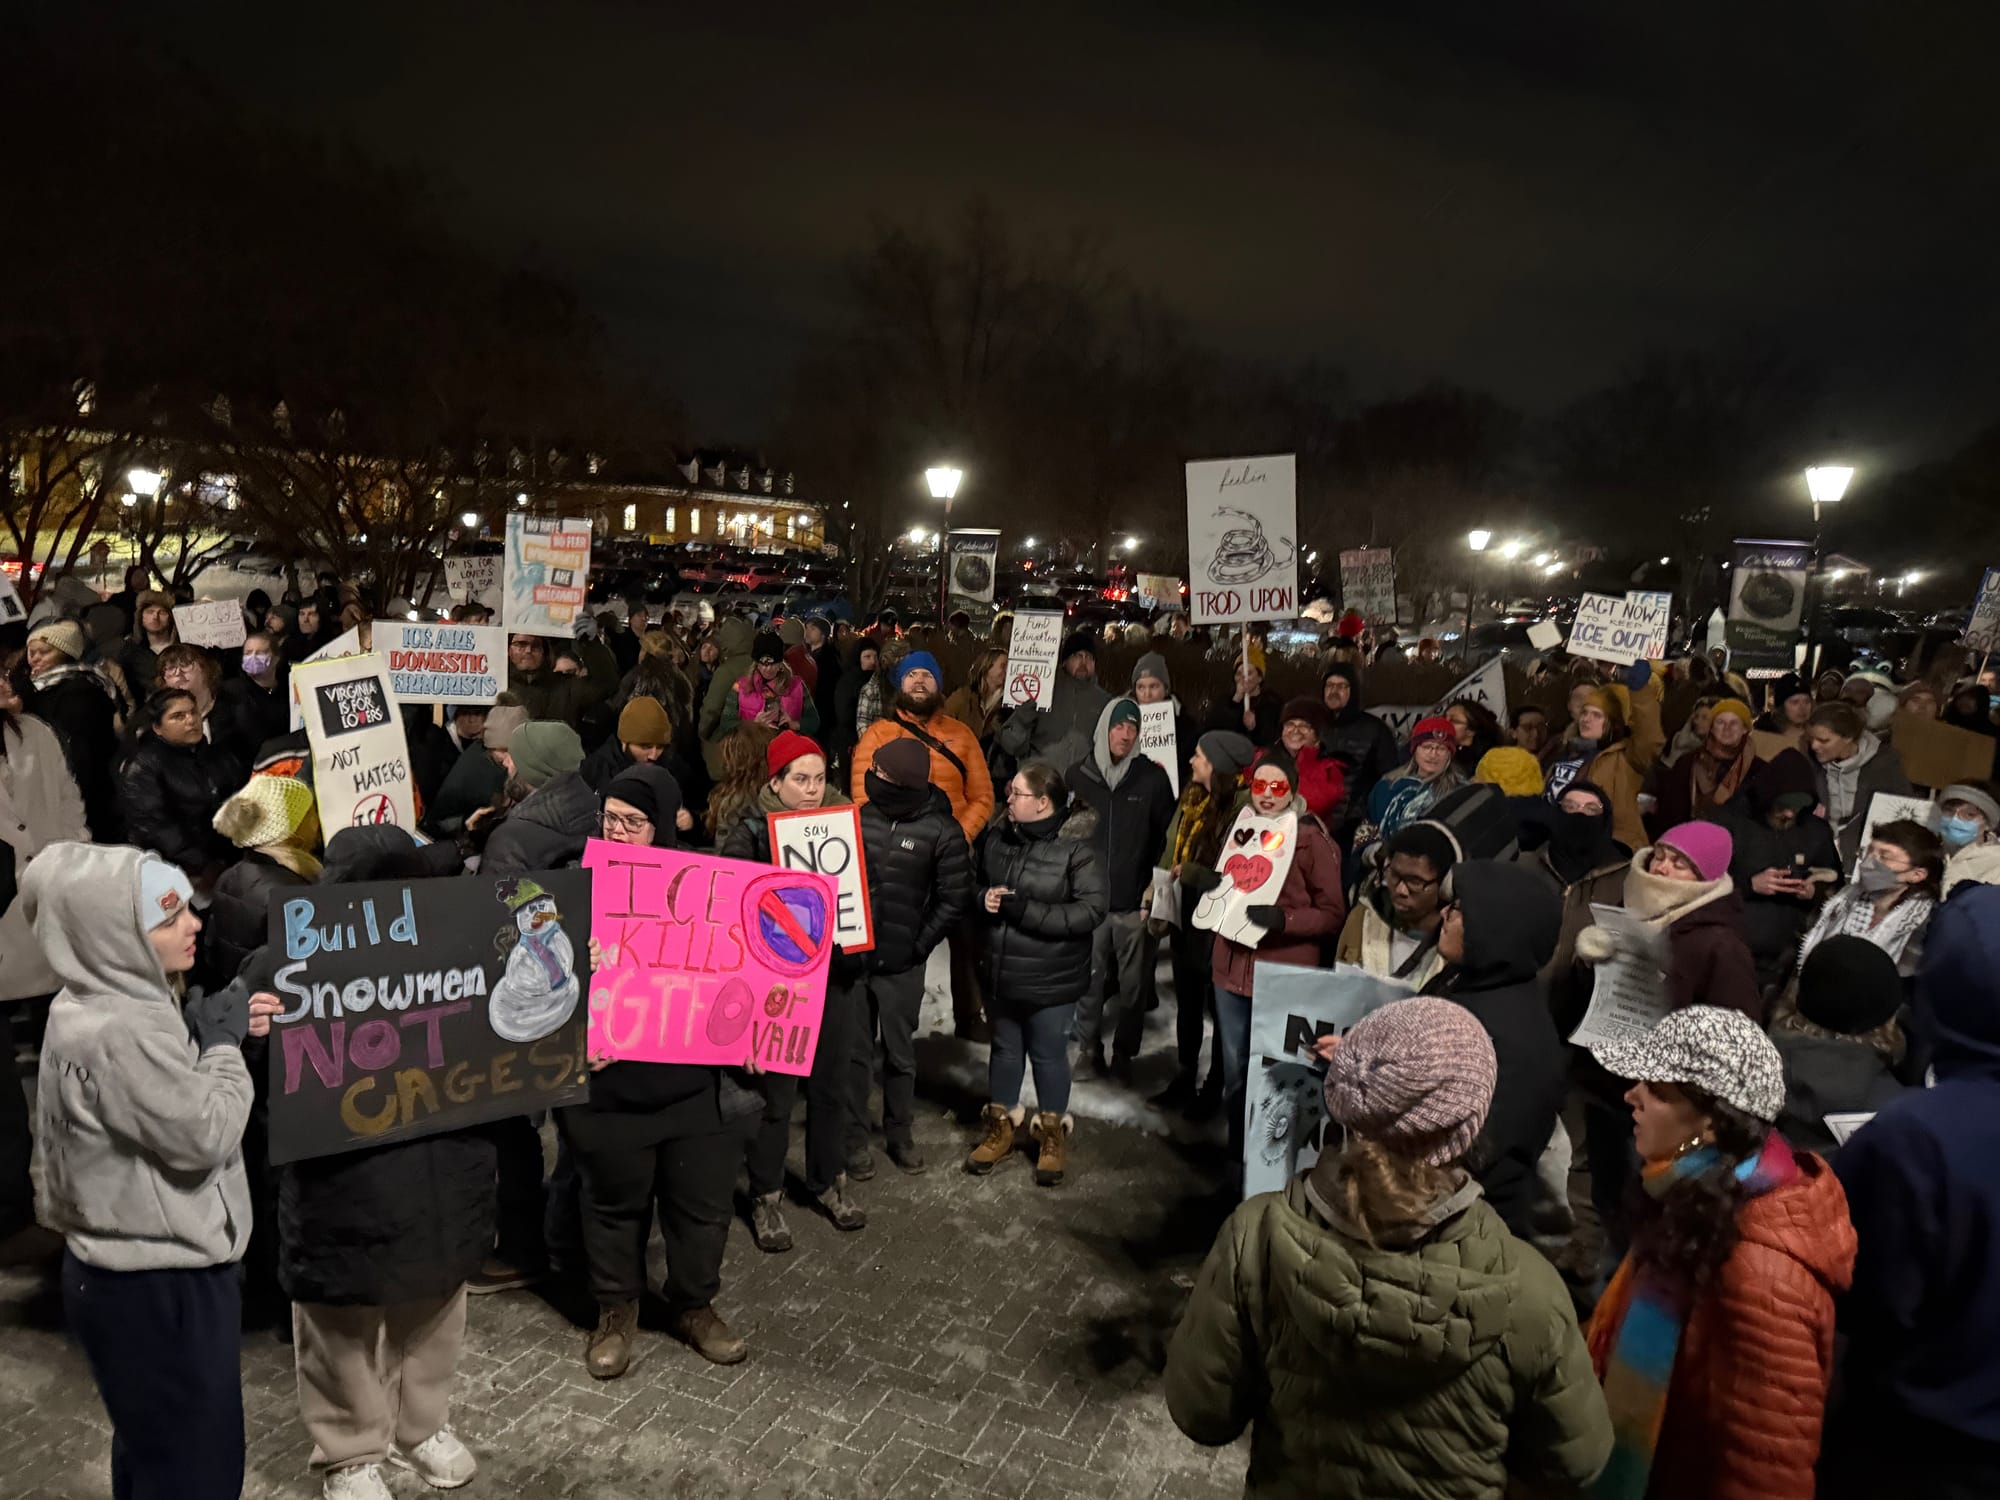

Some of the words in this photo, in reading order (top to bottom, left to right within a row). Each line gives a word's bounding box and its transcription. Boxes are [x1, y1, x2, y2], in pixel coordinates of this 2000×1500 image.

[464, 560, 473, 568] IS
[553, 570, 571, 585] ARE
[1195, 590, 1241, 616] TROD
[1249, 586, 1292, 614] UPON
[1581, 595, 1619, 616] ACT
[402, 627, 434, 649] ICE
[435, 628, 475, 651] ARE
[1572, 622, 1608, 644] ICE
[1611, 629, 1651, 651] OUT
[390, 651, 489, 674] DOMESTIC
[1010, 663, 1052, 679] DEFUND
[324, 681, 378, 703] VIRGINIA
[338, 701, 350, 715] IS
[351, 697, 375, 714] FOR
[330, 746, 361, 771] NOT
[353, 759, 406, 793] HATERS
[803, 823, 829, 839] say
[782, 837, 851, 876] NO
[604, 859, 736, 926] ICE
[283, 886, 419, 961] Build
[617, 922, 745, 974] KILLS
[272, 960, 487, 1023] Snowmen
[764, 982, 813, 1019] OF
[602, 968, 755, 1050] GTFO
[281, 1001, 473, 1095] NOT
[752, 1020, 812, 1065] VA!!
[1283, 1013, 1351, 1066] N
[340, 1022, 587, 1136] CAGES!
